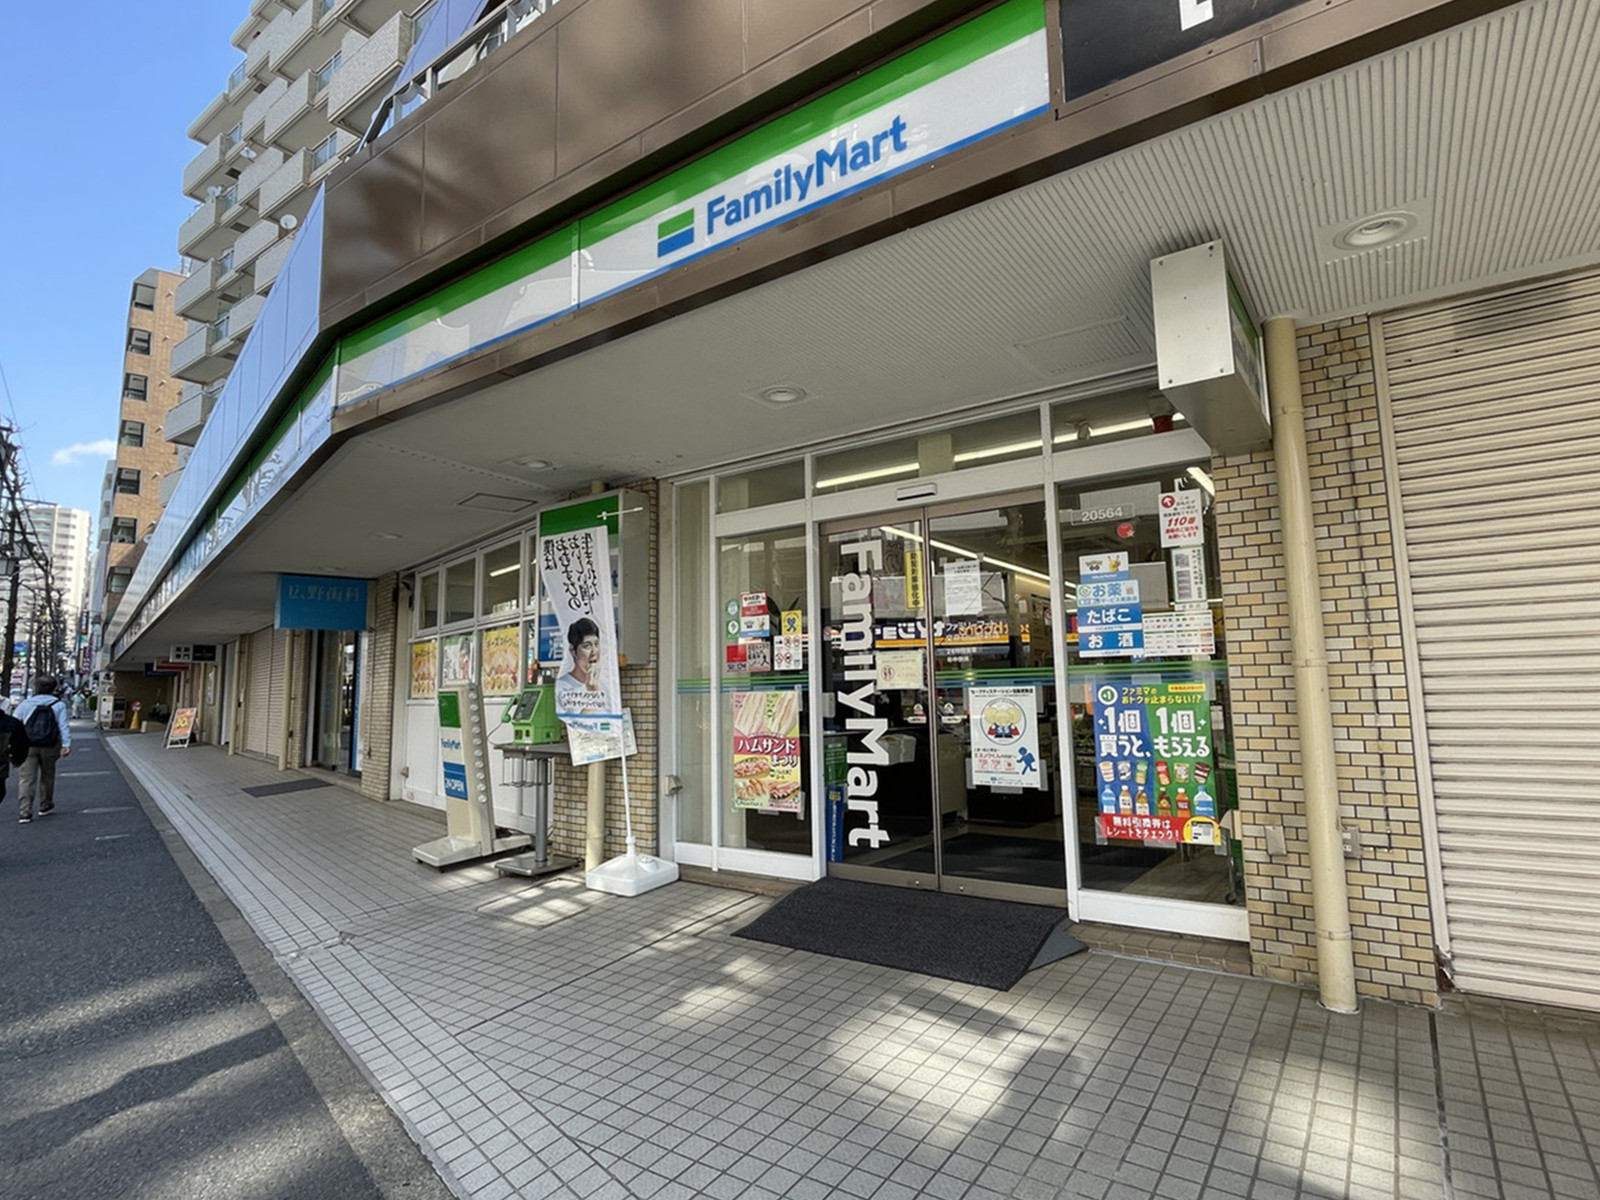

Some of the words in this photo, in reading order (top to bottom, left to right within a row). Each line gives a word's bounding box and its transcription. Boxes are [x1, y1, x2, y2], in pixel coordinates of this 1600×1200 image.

[706, 115, 907, 236] FamilyMart
[1082, 506, 1123, 522] 20564
[1092, 582, 1122, 598] お薬
[1086, 608, 1132, 624] たばこ
[1088, 632, 1134, 649] お酒
[838, 539, 890, 848] FamilyMart
[1122, 687, 1157, 696] ファミマの
[1104, 707, 1141, 734] 1個
[1156, 707, 1196, 734] 1個
[738, 738, 796, 754] ハムサンド
[1100, 734, 1152, 758] 買うと、
[1153, 736, 1210, 758] もらえる
[771, 755, 798, 768] まつり
[1106, 827, 1180, 840] レシートをチェック!
